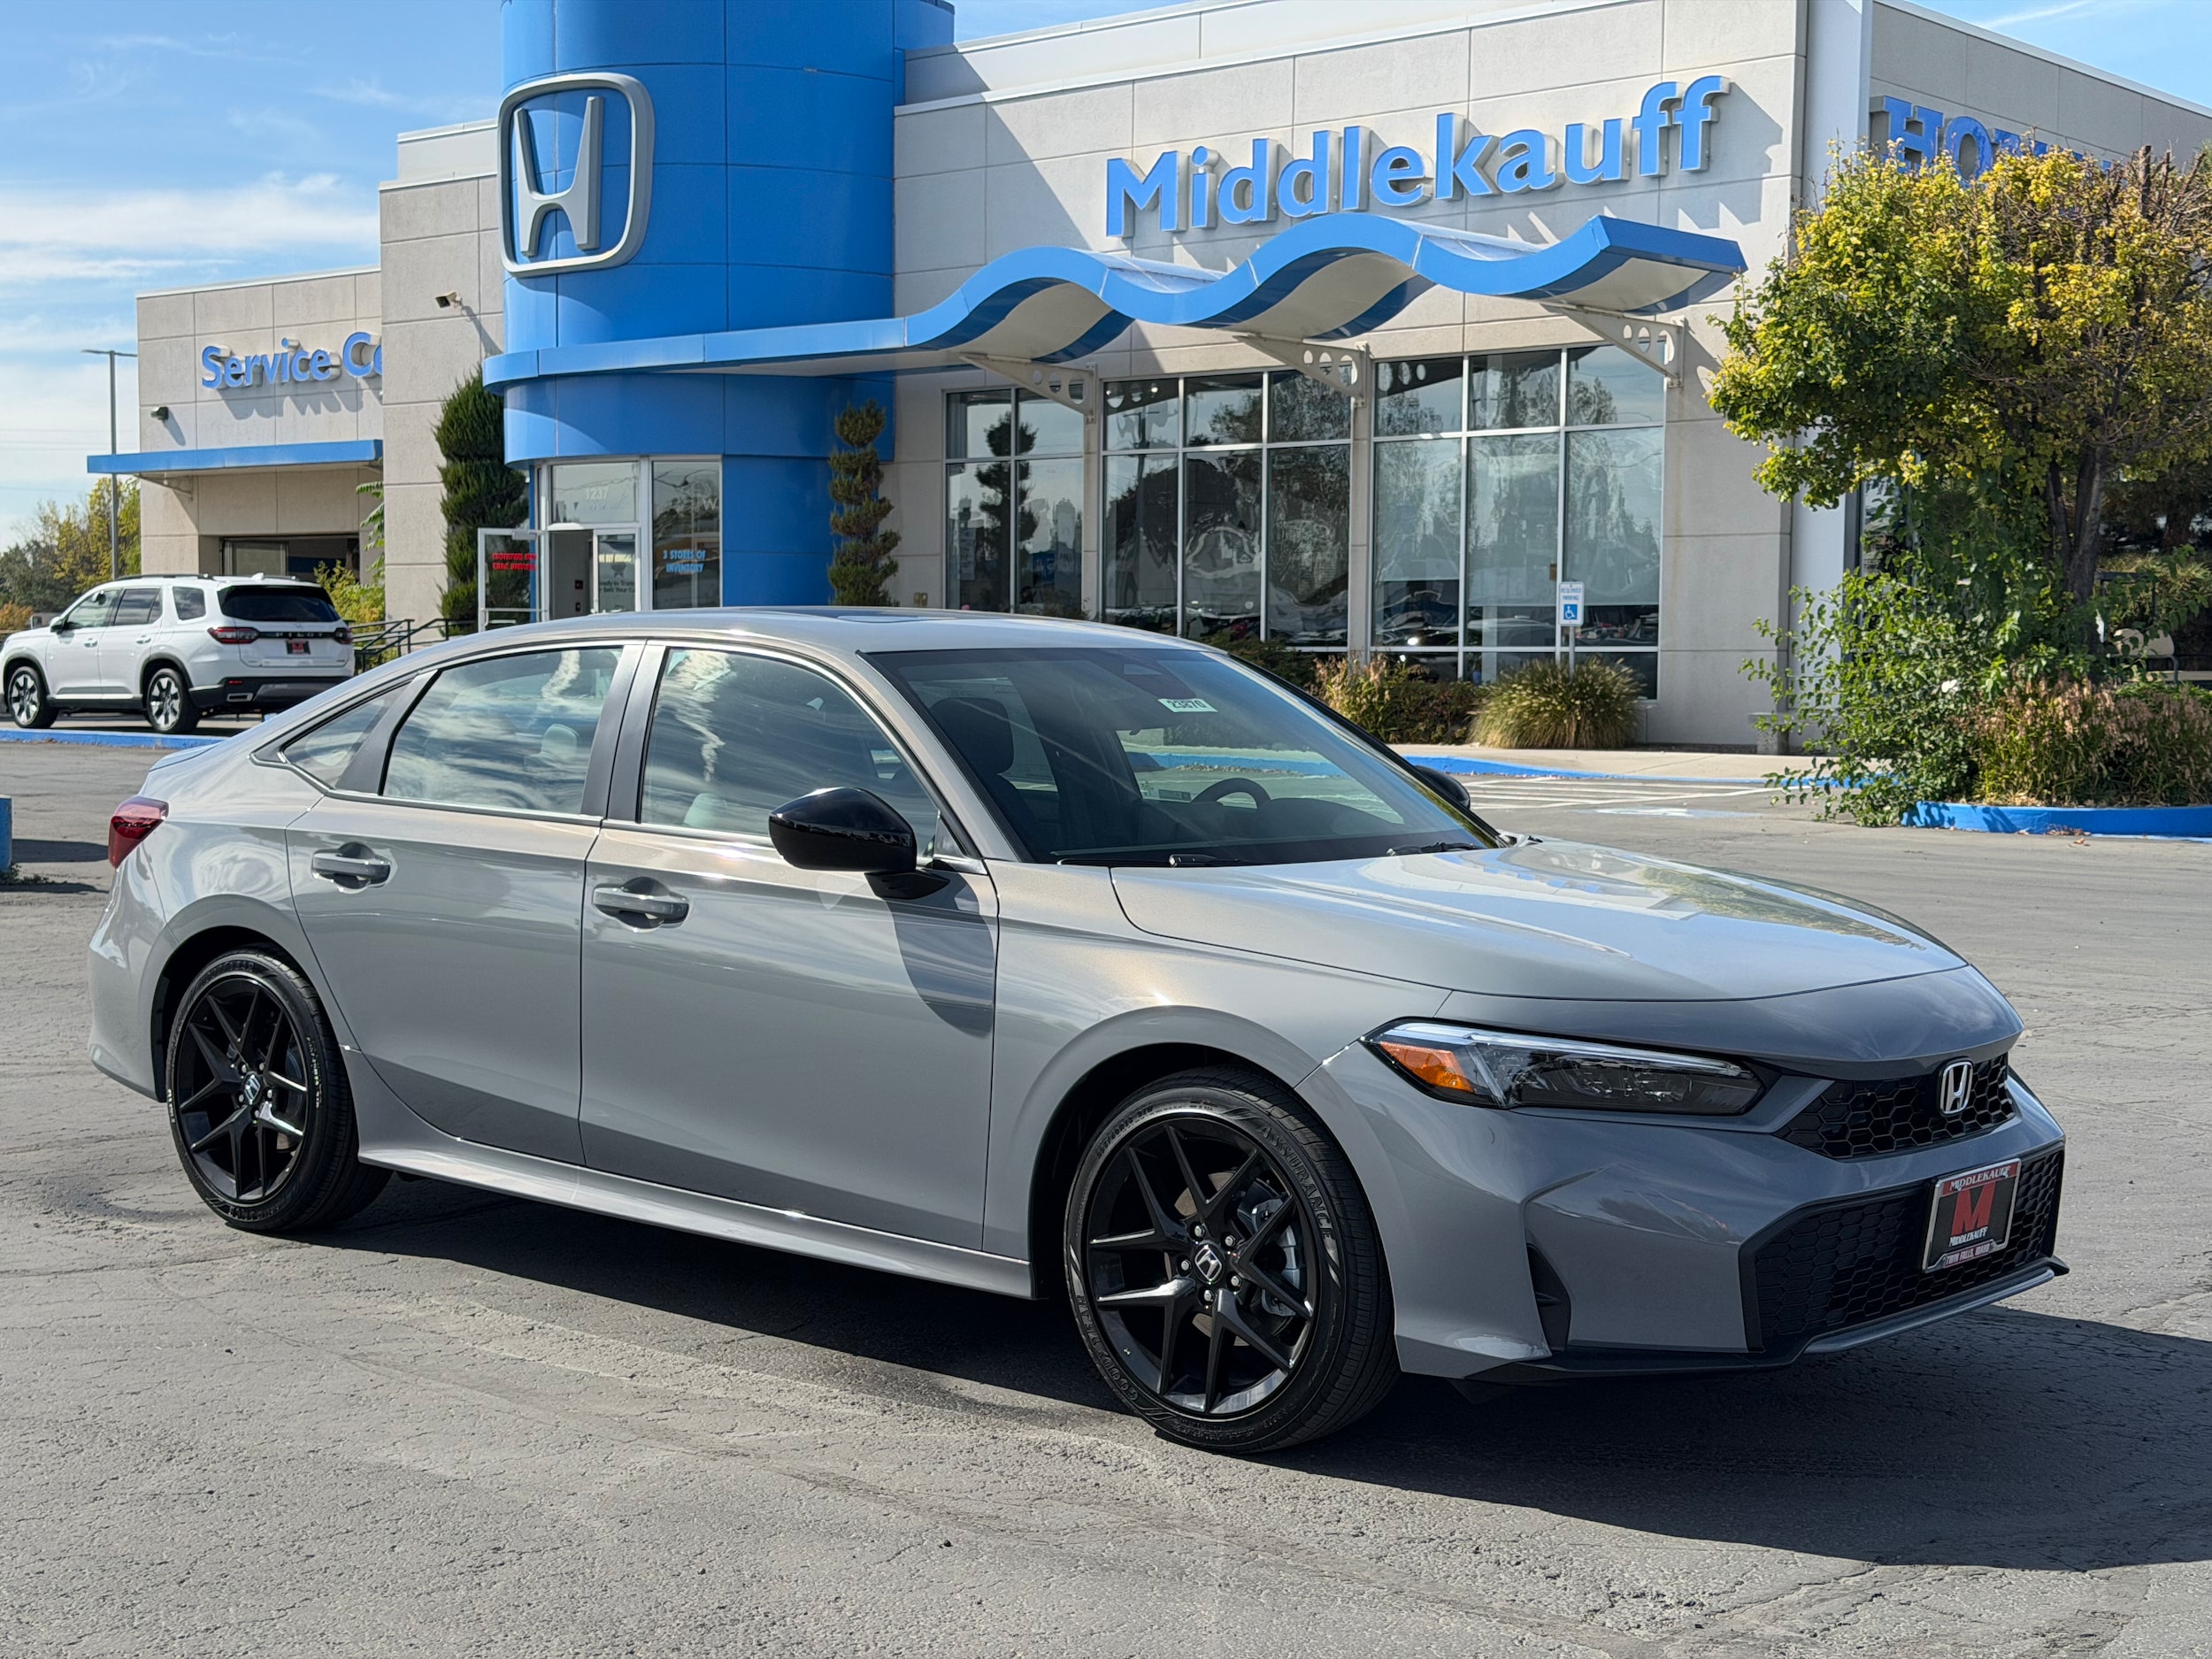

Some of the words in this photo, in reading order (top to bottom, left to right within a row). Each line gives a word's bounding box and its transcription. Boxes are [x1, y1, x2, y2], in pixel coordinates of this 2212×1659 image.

[1106, 75, 1727, 237] Middlekauff
[202, 337, 333, 389] Service
[586, 487, 609, 500] 1237
[670, 549, 694, 559] STORES
[695, 549, 705, 560] OF
[665, 563, 703, 573] INVENTORY
[1256, 1124, 1334, 1240] ASSURANCE
[1949, 1165, 2011, 1191] MDDLEKAUF
[1948, 1226, 1988, 1247] MIDDLEKAUFF
